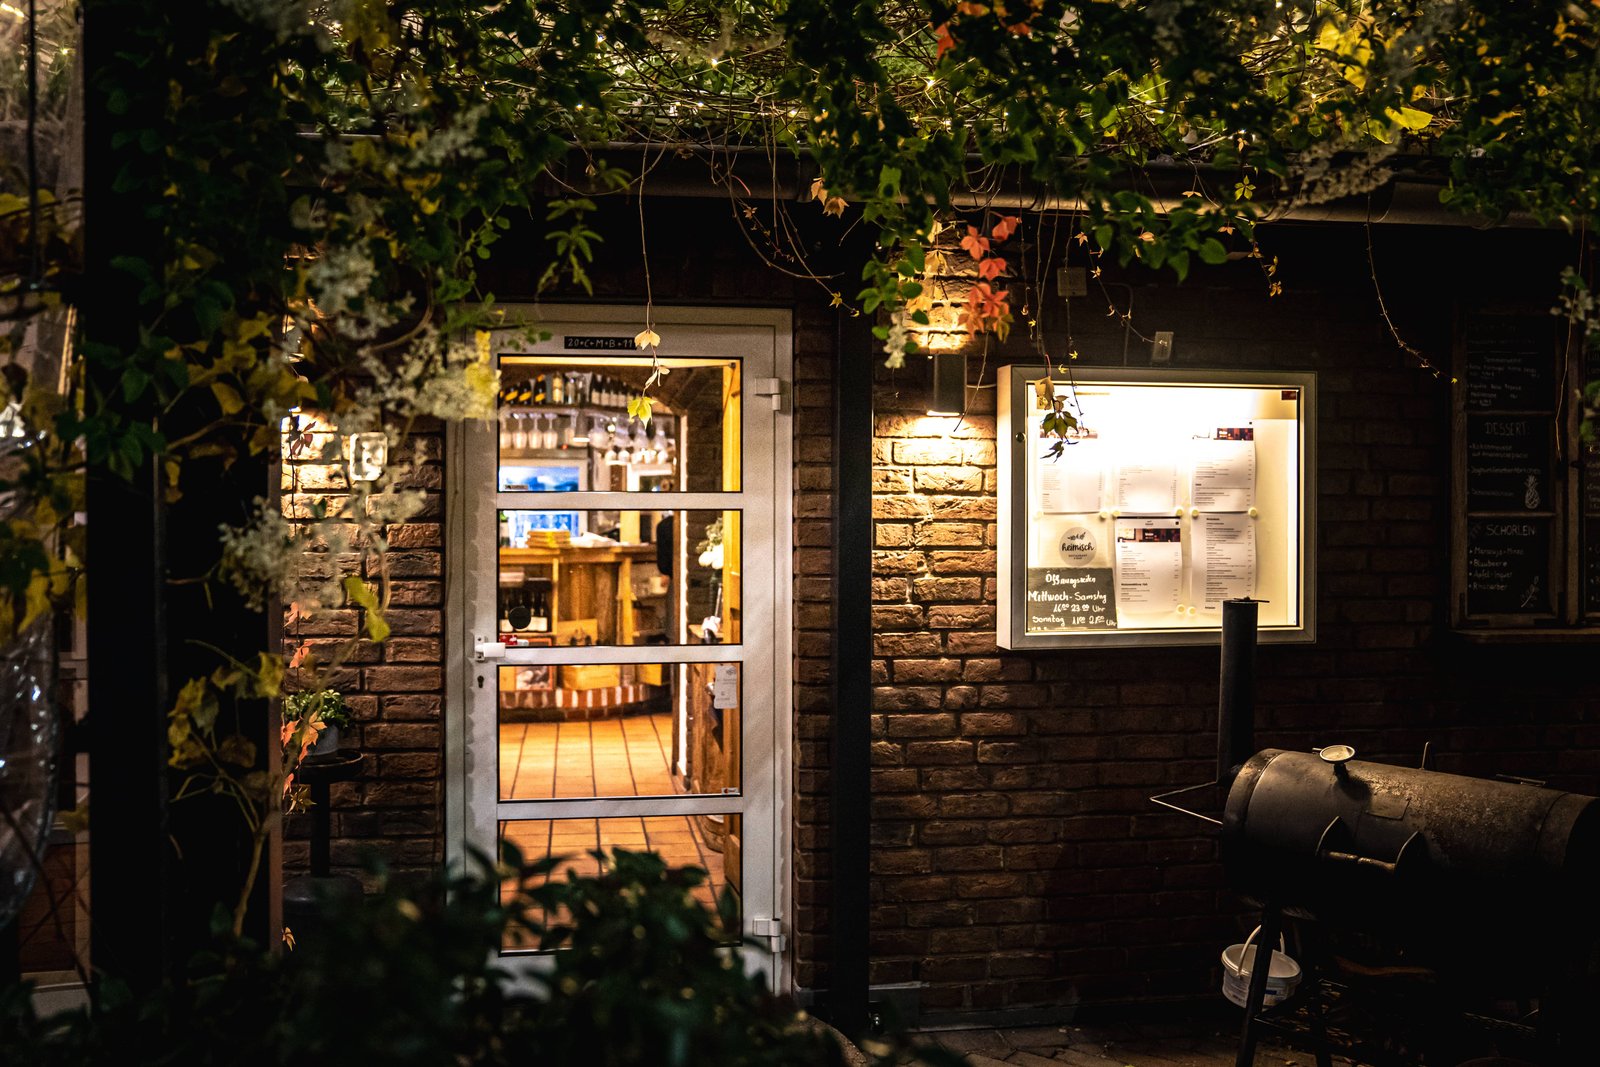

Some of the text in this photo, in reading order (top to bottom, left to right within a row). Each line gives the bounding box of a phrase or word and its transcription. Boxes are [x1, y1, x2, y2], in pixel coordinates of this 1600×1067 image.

[1485, 420, 1528, 437] DESSERT
[1486, 523, 1535, 536] SCHORLEN
[1061, 541, 1095, 552] heimisch
[1092, 604, 1106, 613] Uhr
[1032, 614, 1066, 627] Sonntag
